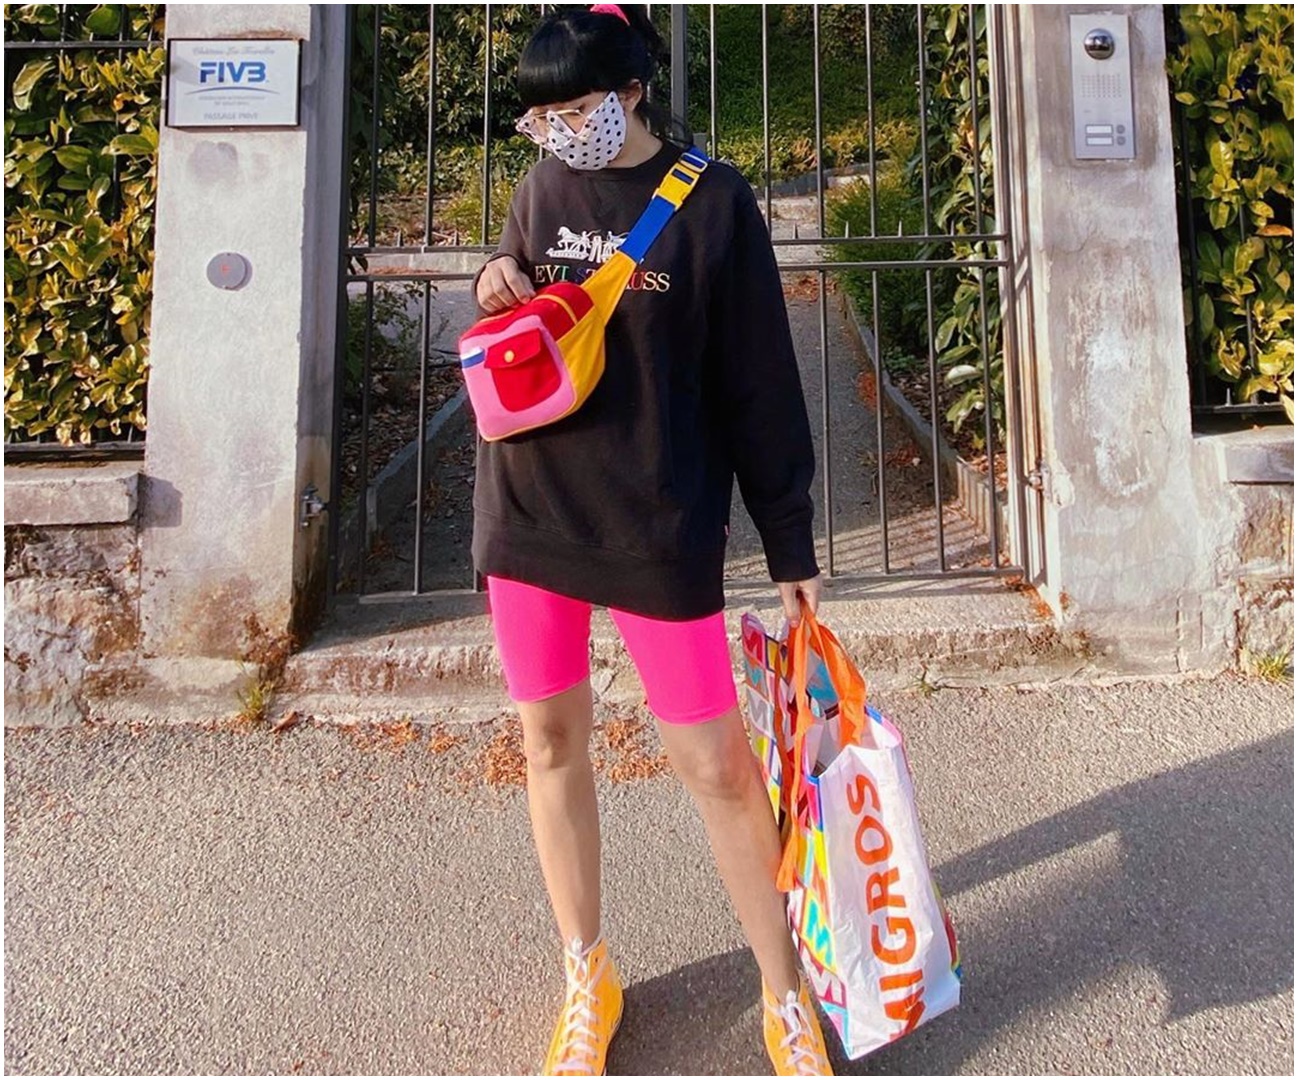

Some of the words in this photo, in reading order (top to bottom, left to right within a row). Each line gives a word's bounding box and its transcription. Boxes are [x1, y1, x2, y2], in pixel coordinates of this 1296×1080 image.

[200, 61, 266, 83] FIVB
[533, 264, 570, 283] EVI
[575, 267, 670, 293] STUSS
